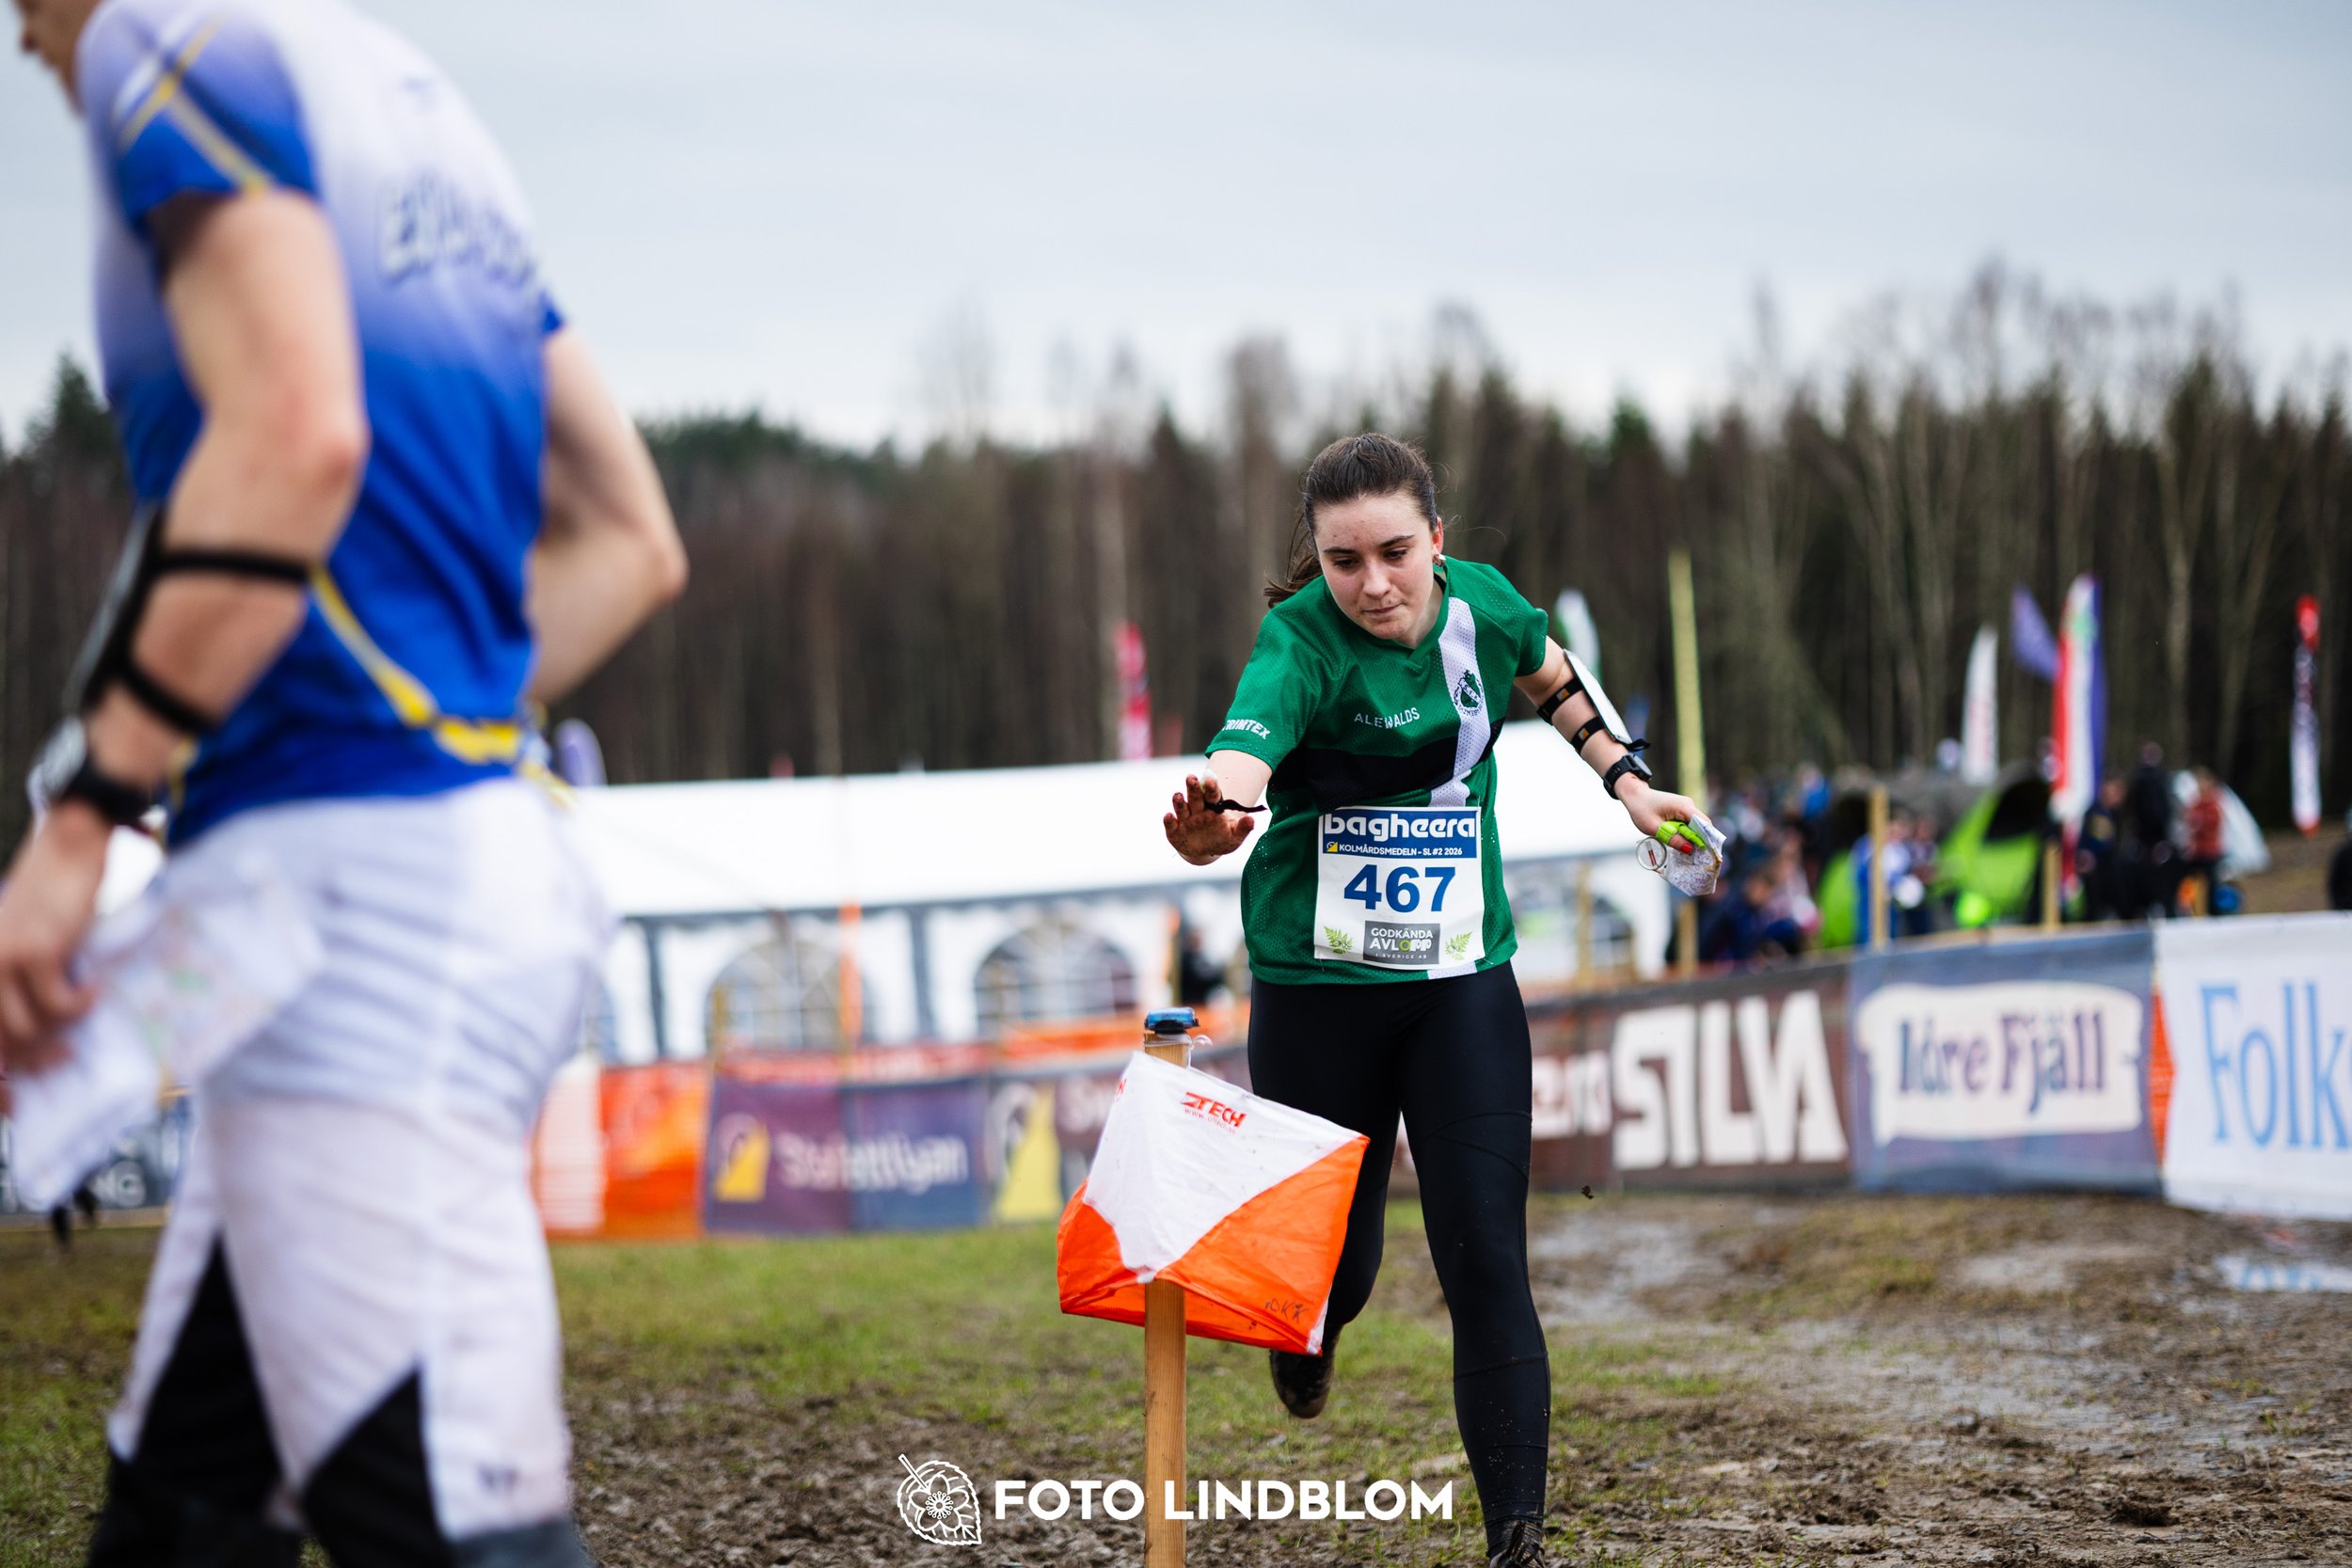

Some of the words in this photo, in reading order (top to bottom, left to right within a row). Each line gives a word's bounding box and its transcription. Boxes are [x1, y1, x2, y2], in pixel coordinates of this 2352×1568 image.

[1354, 707, 1420, 730] ALEWALDS
[1325, 813, 1475, 842] bagheera
[1339, 844, 1417, 856] KOLMÅRDSMEDELN
[1444, 847, 1463, 856] 2026
[1343, 864, 1455, 912] 467
[1371, 927, 1434, 939] GODKÄNDA
[1613, 990, 1848, 1170] SILVA
[1898, 1020, 1990, 1095] Idre
[1999, 1011, 2107, 1114] Fjäll
[2200, 983, 2352, 1150] Folk
